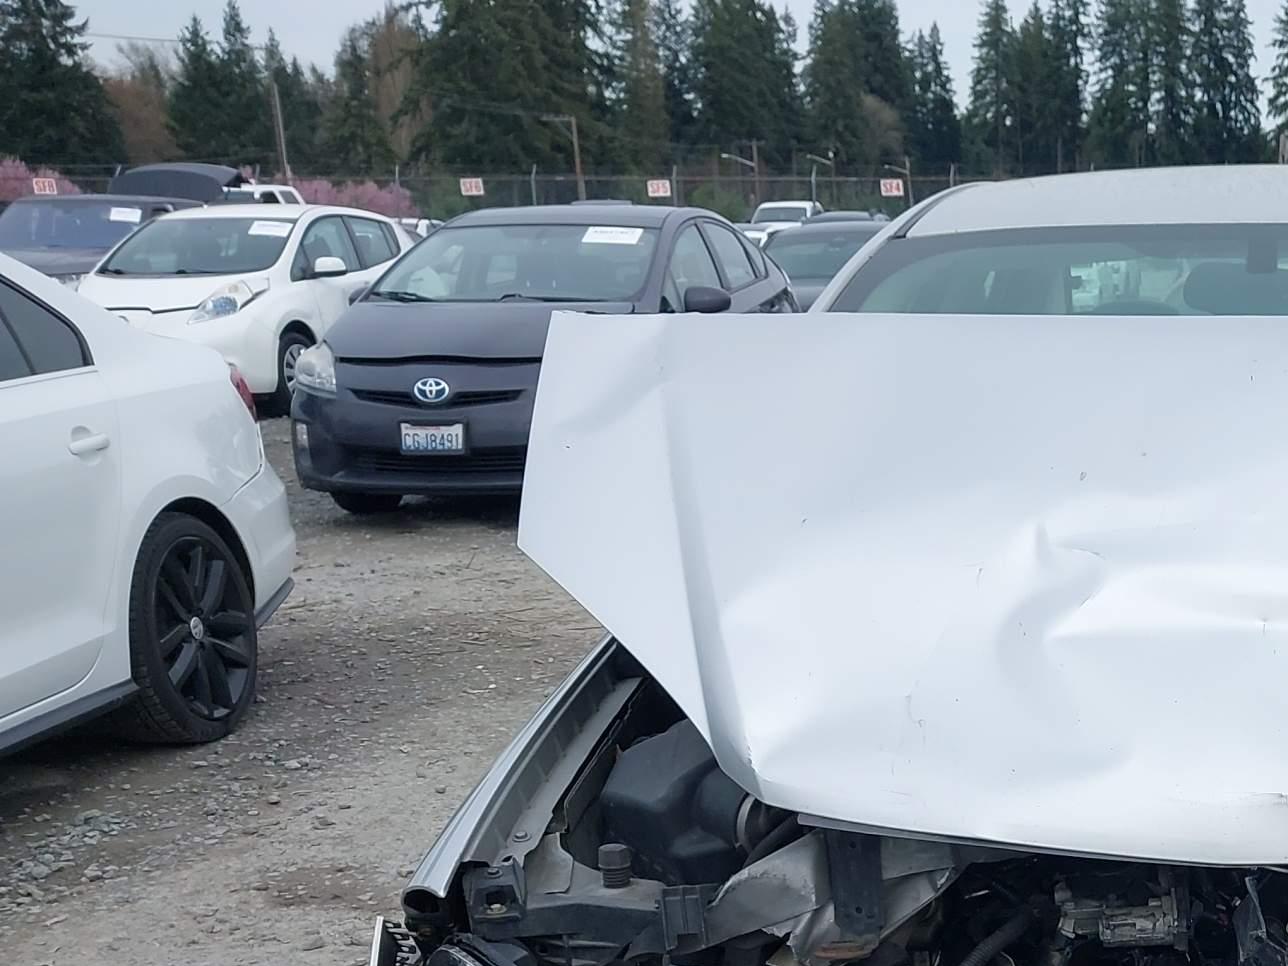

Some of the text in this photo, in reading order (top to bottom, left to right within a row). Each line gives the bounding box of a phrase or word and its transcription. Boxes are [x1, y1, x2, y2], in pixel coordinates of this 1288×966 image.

[650, 181, 669, 195] SF5
[882, 181, 901, 194] SF4
[403, 432, 459, 450] CGJ8491
